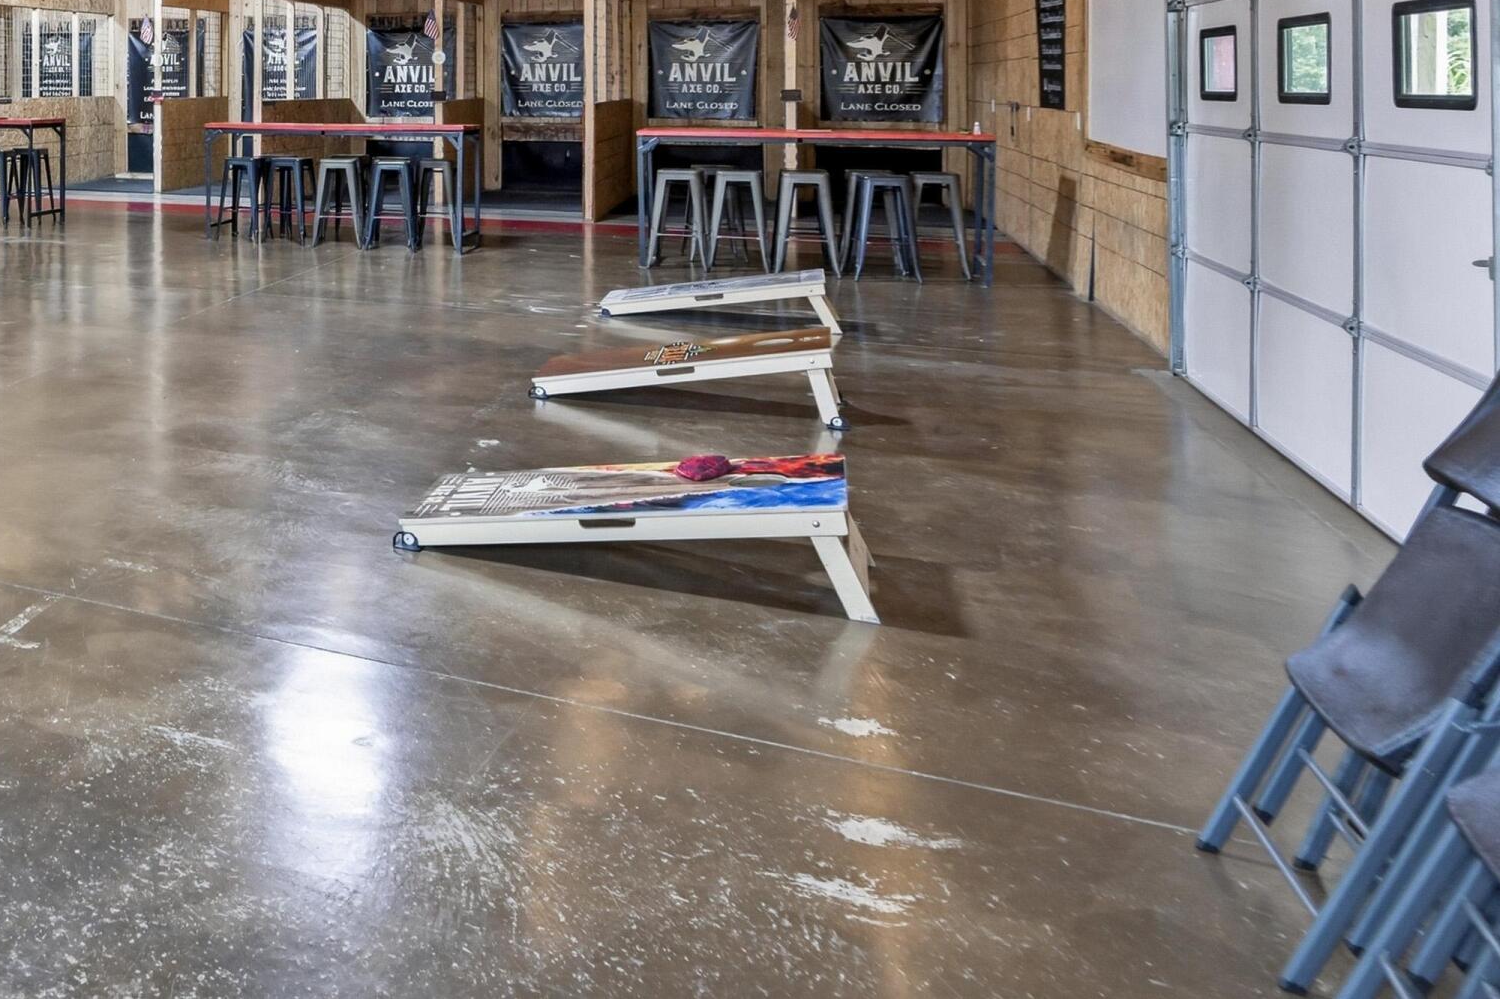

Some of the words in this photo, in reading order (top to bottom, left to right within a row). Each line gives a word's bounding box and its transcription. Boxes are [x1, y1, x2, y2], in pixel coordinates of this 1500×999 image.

[519, 63, 582, 82] ANVIL
[668, 62, 737, 82] ANVIL
[843, 62, 919, 82] ANVIL
[394, 84, 413, 93] AXE
[414, 84, 429, 93] CO.
[531, 83, 552, 93] AXE
[553, 83, 569, 93] CO.
[681, 83, 703, 94] AXE
[705, 83, 723, 94] CO.
[857, 83, 883, 94] AXE
[885, 83, 904, 94] CO.
